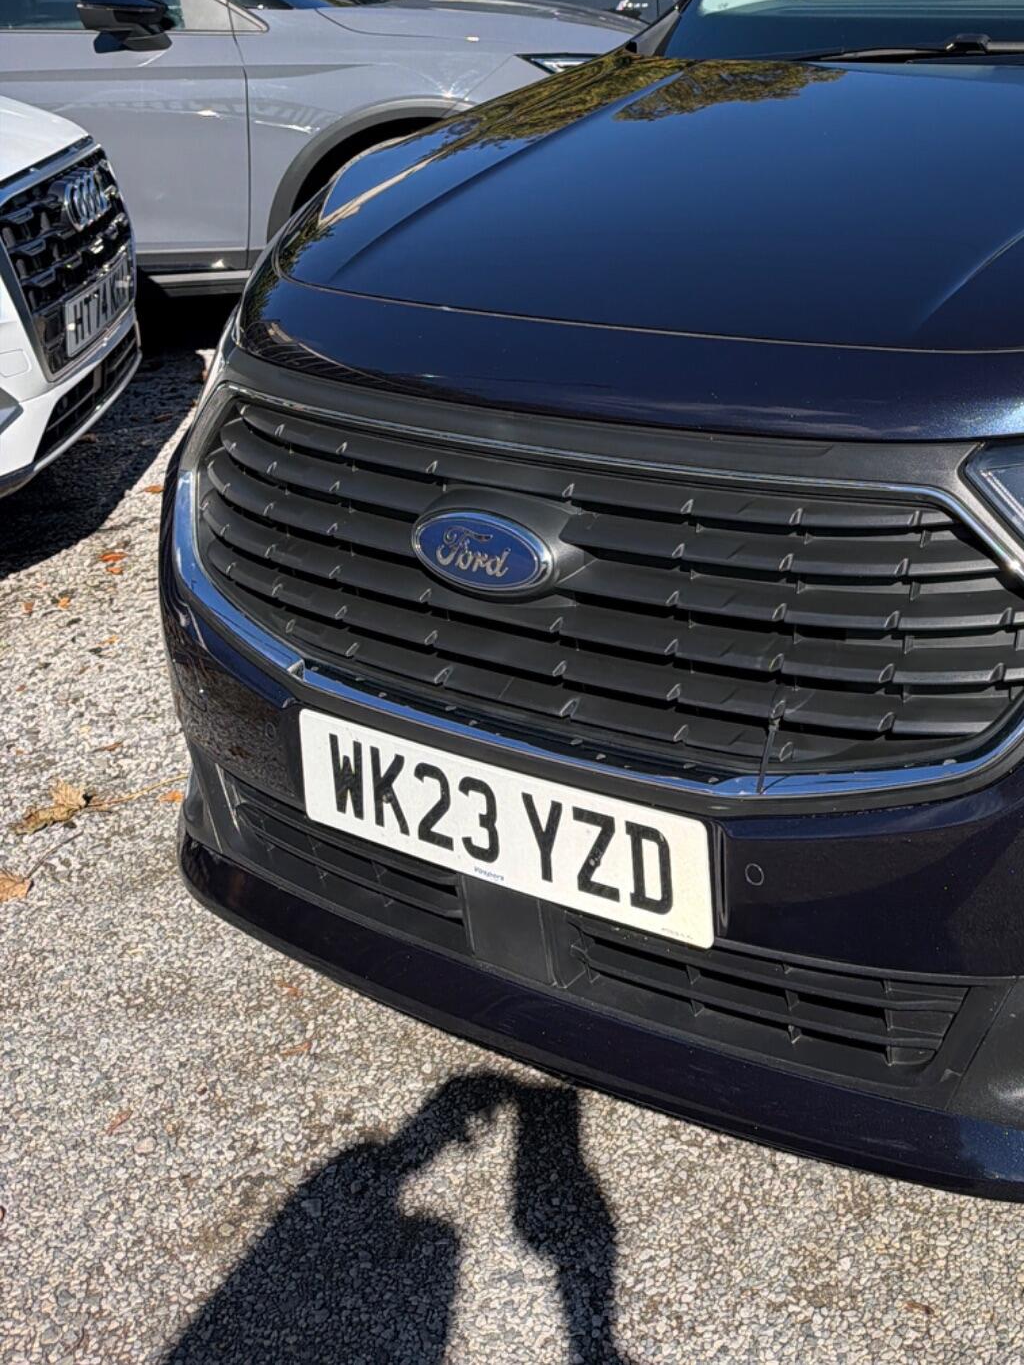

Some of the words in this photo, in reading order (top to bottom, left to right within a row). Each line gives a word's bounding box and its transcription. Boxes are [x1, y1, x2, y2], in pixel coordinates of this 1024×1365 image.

[435, 525, 511, 578] Ford
[328, 733, 500, 863] WK23
[521, 791, 673, 915] YZD
